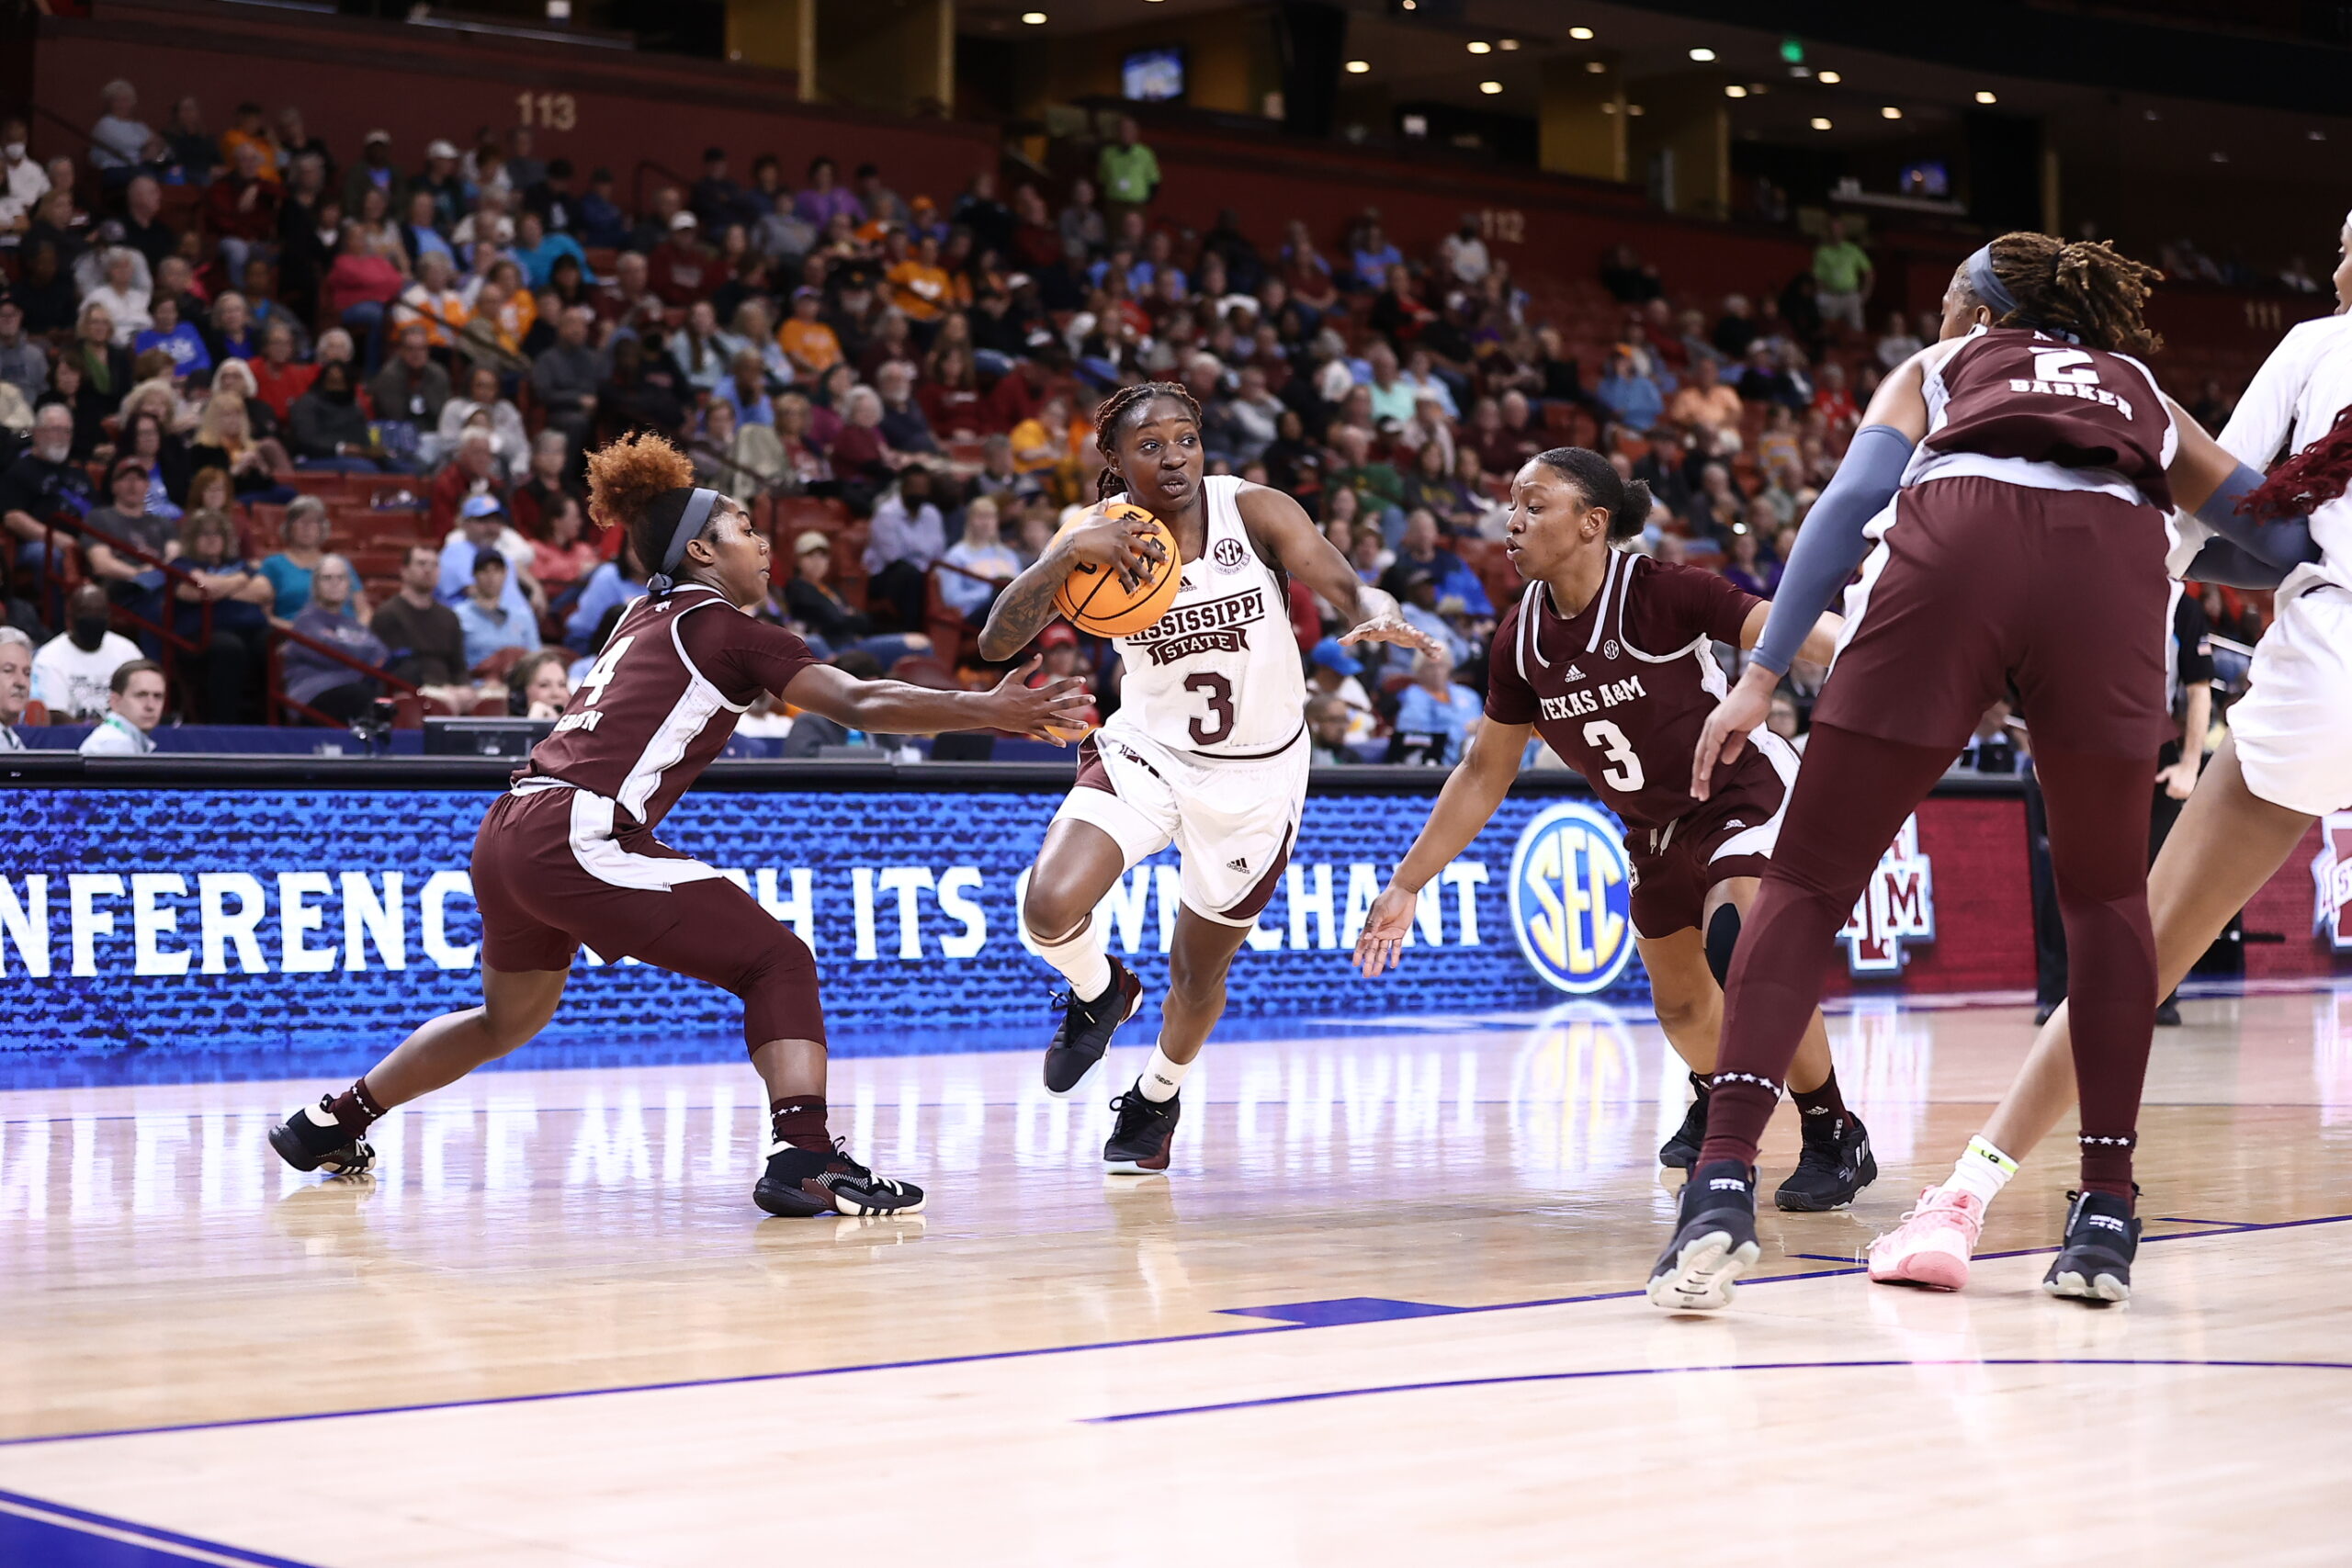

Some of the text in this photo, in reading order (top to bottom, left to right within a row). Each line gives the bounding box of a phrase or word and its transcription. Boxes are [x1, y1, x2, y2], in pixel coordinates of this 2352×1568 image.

[515, 93, 576, 130] 113
[1482, 208, 1525, 244] 112
[2028, 346, 2100, 384] 2
[2008, 378, 2133, 422] BARKER
[1216, 540, 1242, 565] SEC
[1125, 592, 1264, 641] SSISSIPPI
[1164, 634, 1231, 660] STATE
[581, 636, 636, 707] 4
[1565, 672, 1587, 682] adidas
[1184, 672, 1233, 745] 3
[1540, 674, 1646, 720] TEXAS A&M
[1582, 719, 1645, 792] 3
[1226, 863, 1250, 874] adidas
[852, 867, 987, 960] ITS
[1525, 826, 1624, 974] SEC
